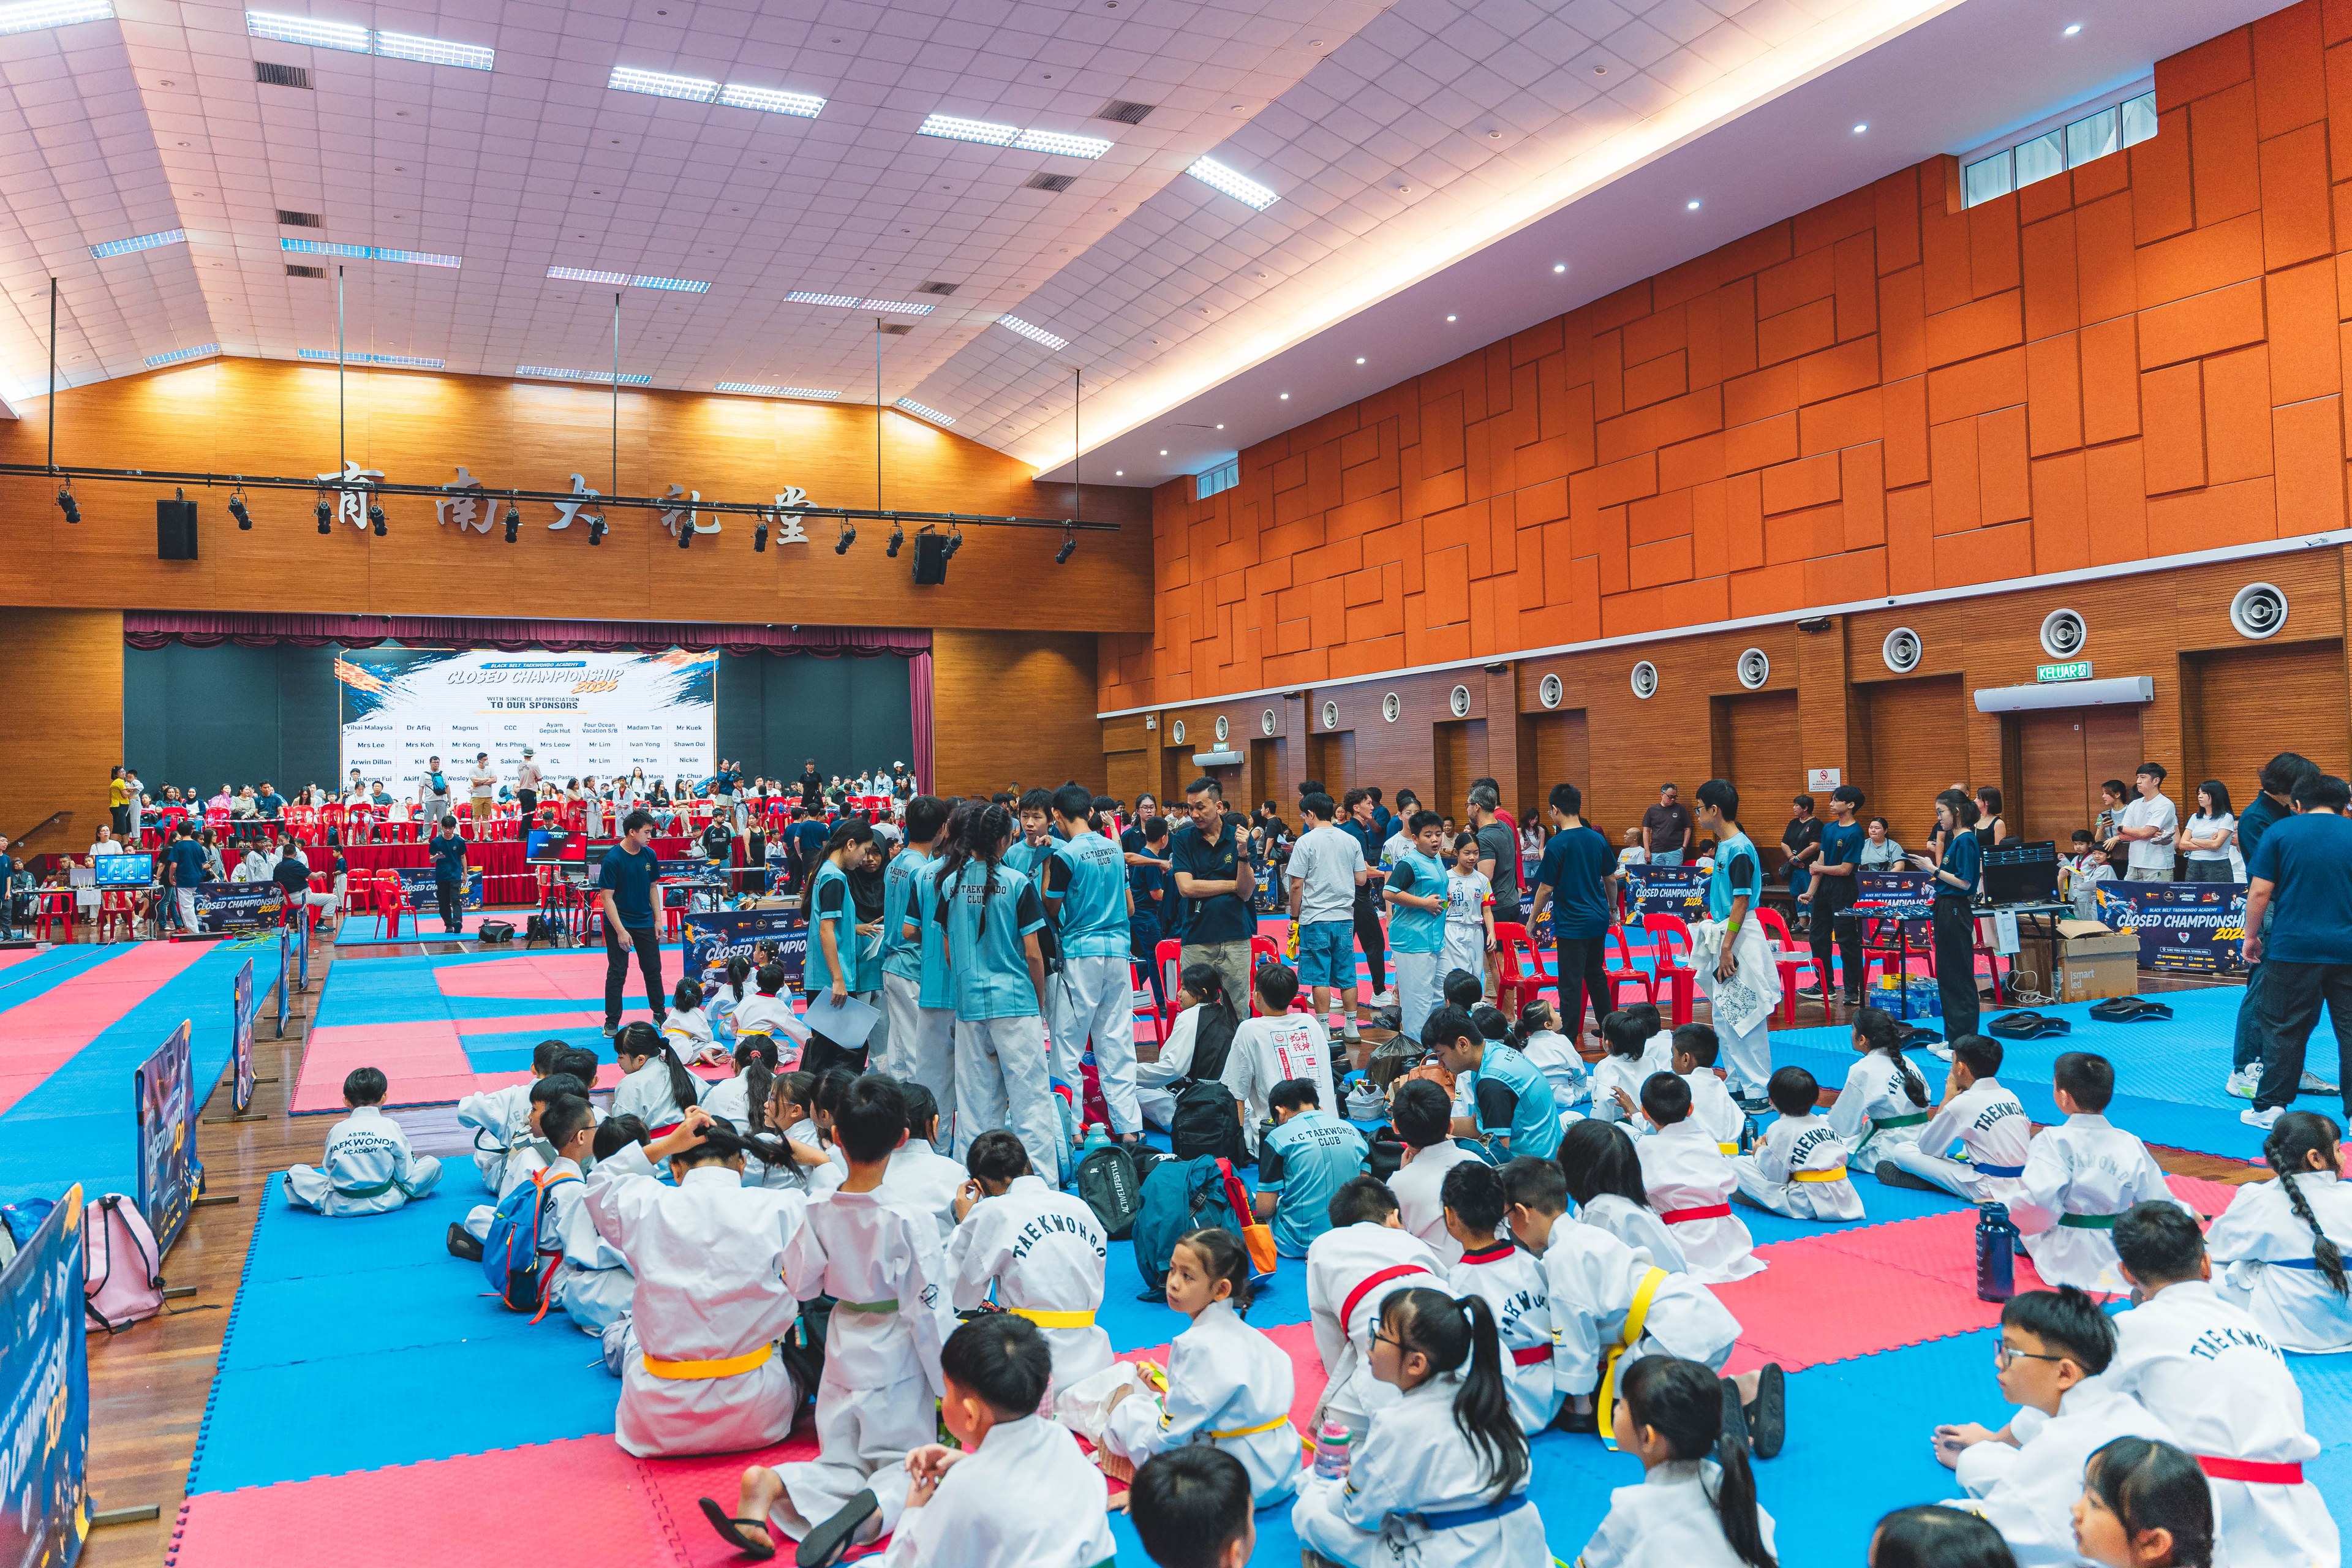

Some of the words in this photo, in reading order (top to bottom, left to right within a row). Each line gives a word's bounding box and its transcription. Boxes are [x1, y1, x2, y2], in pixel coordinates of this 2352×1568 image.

[447, 670, 507, 685] CLOSED
[511, 669, 624, 684] CHAMPIONSHIP
[2040, 665, 2077, 680] KELUAR
[571, 680, 618, 694] 2026
[1080, 852, 1090, 861] K.C
[1097, 857, 1111, 865] CLUB
[961, 885, 1006, 895] TAEKWDO
[1635, 888, 1659, 898] CLOSED
[1659, 888, 1705, 898] CHAMPIONSHIP
[196, 901, 227, 911] CLOSED
[228, 897, 284, 908] CHAMPIONSHIP
[967, 895, 984, 904] CLU
[1684, 897, 1703, 907] 2026
[257, 904, 281, 914] 2026
[2117, 914, 2162, 928] CLOSED
[2163, 914, 2245, 929] CHAMPIONSHI
[705, 944, 753, 962] CLOSED
[1317, 1136, 1341, 1147] CLUB
[1110, 1160, 1130, 1214] ACTIVELIFESTYLE
[2190, 1327, 2280, 1362] TAEKWON
